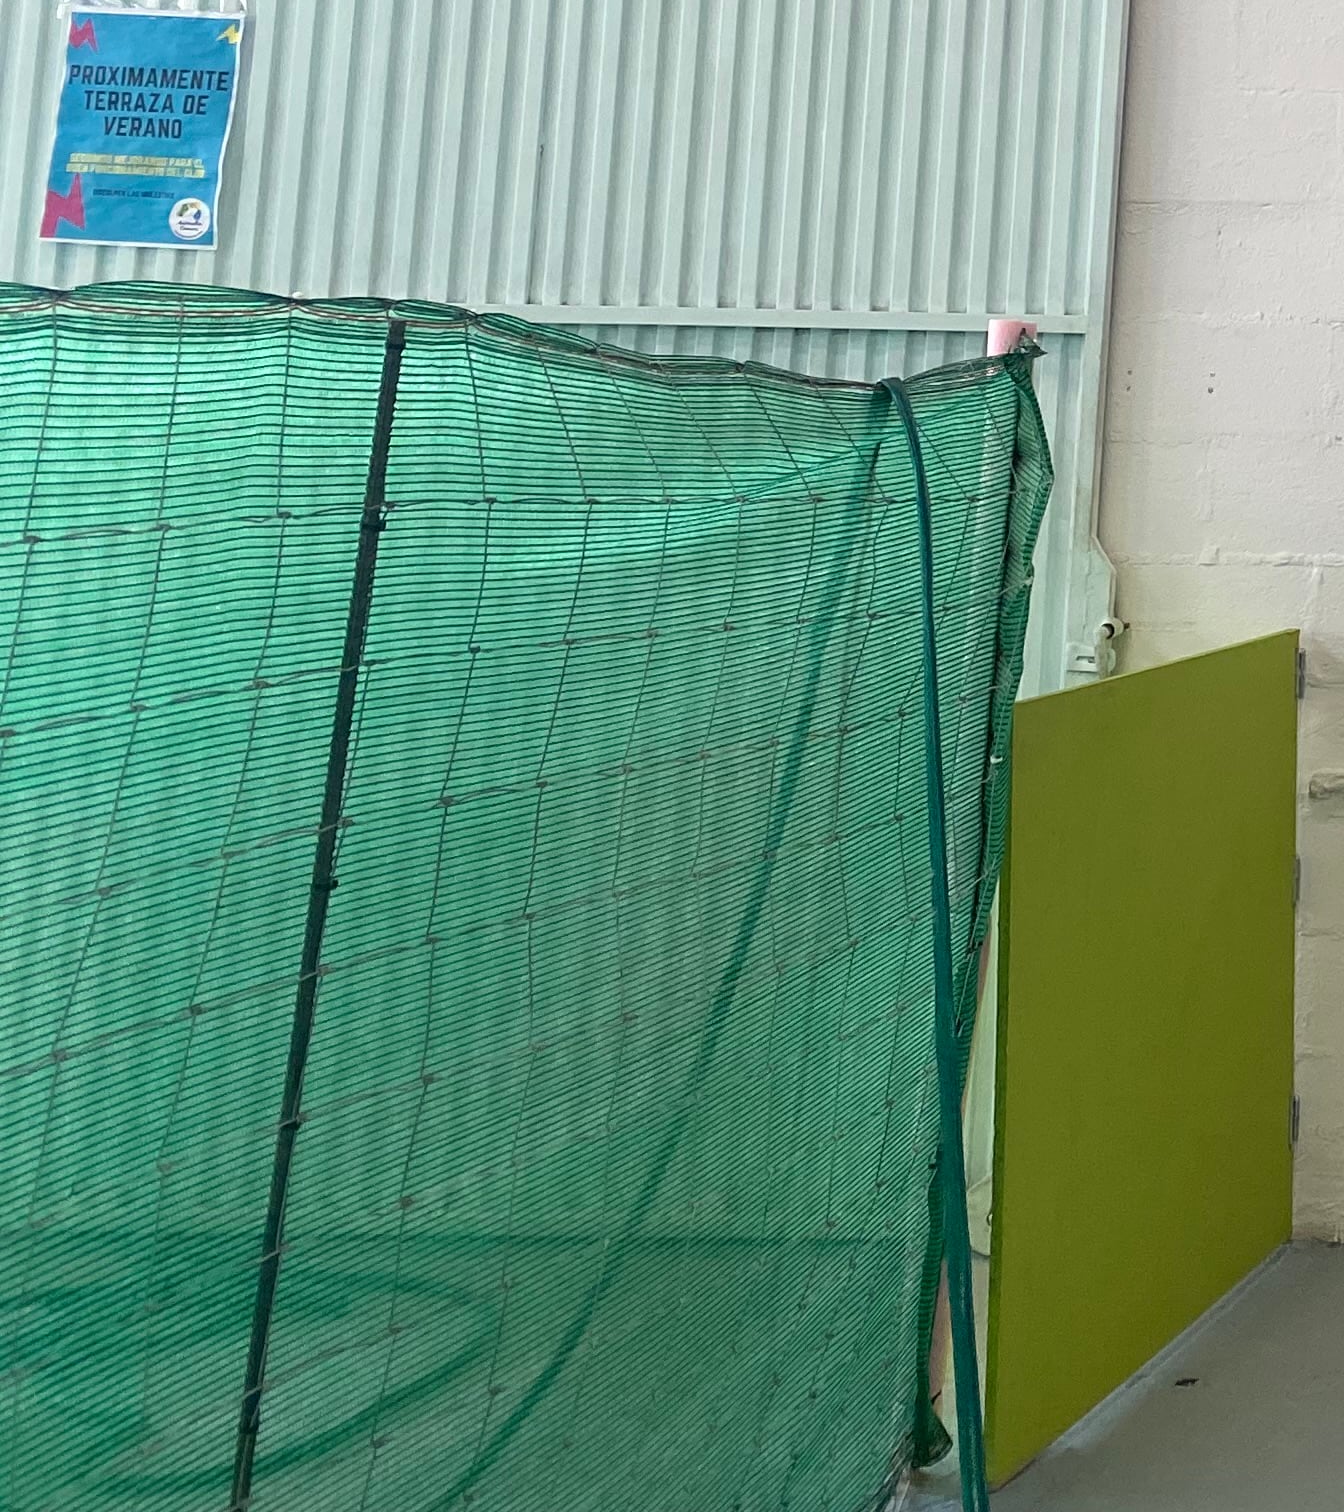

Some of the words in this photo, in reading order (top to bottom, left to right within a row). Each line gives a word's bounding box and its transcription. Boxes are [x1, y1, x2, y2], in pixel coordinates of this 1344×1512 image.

[68, 65, 229, 91] PROXIMAMENTE
[84, 90, 174, 113] TERRAZA
[182, 94, 209, 115] DE
[104, 116, 182, 139] VERANO
